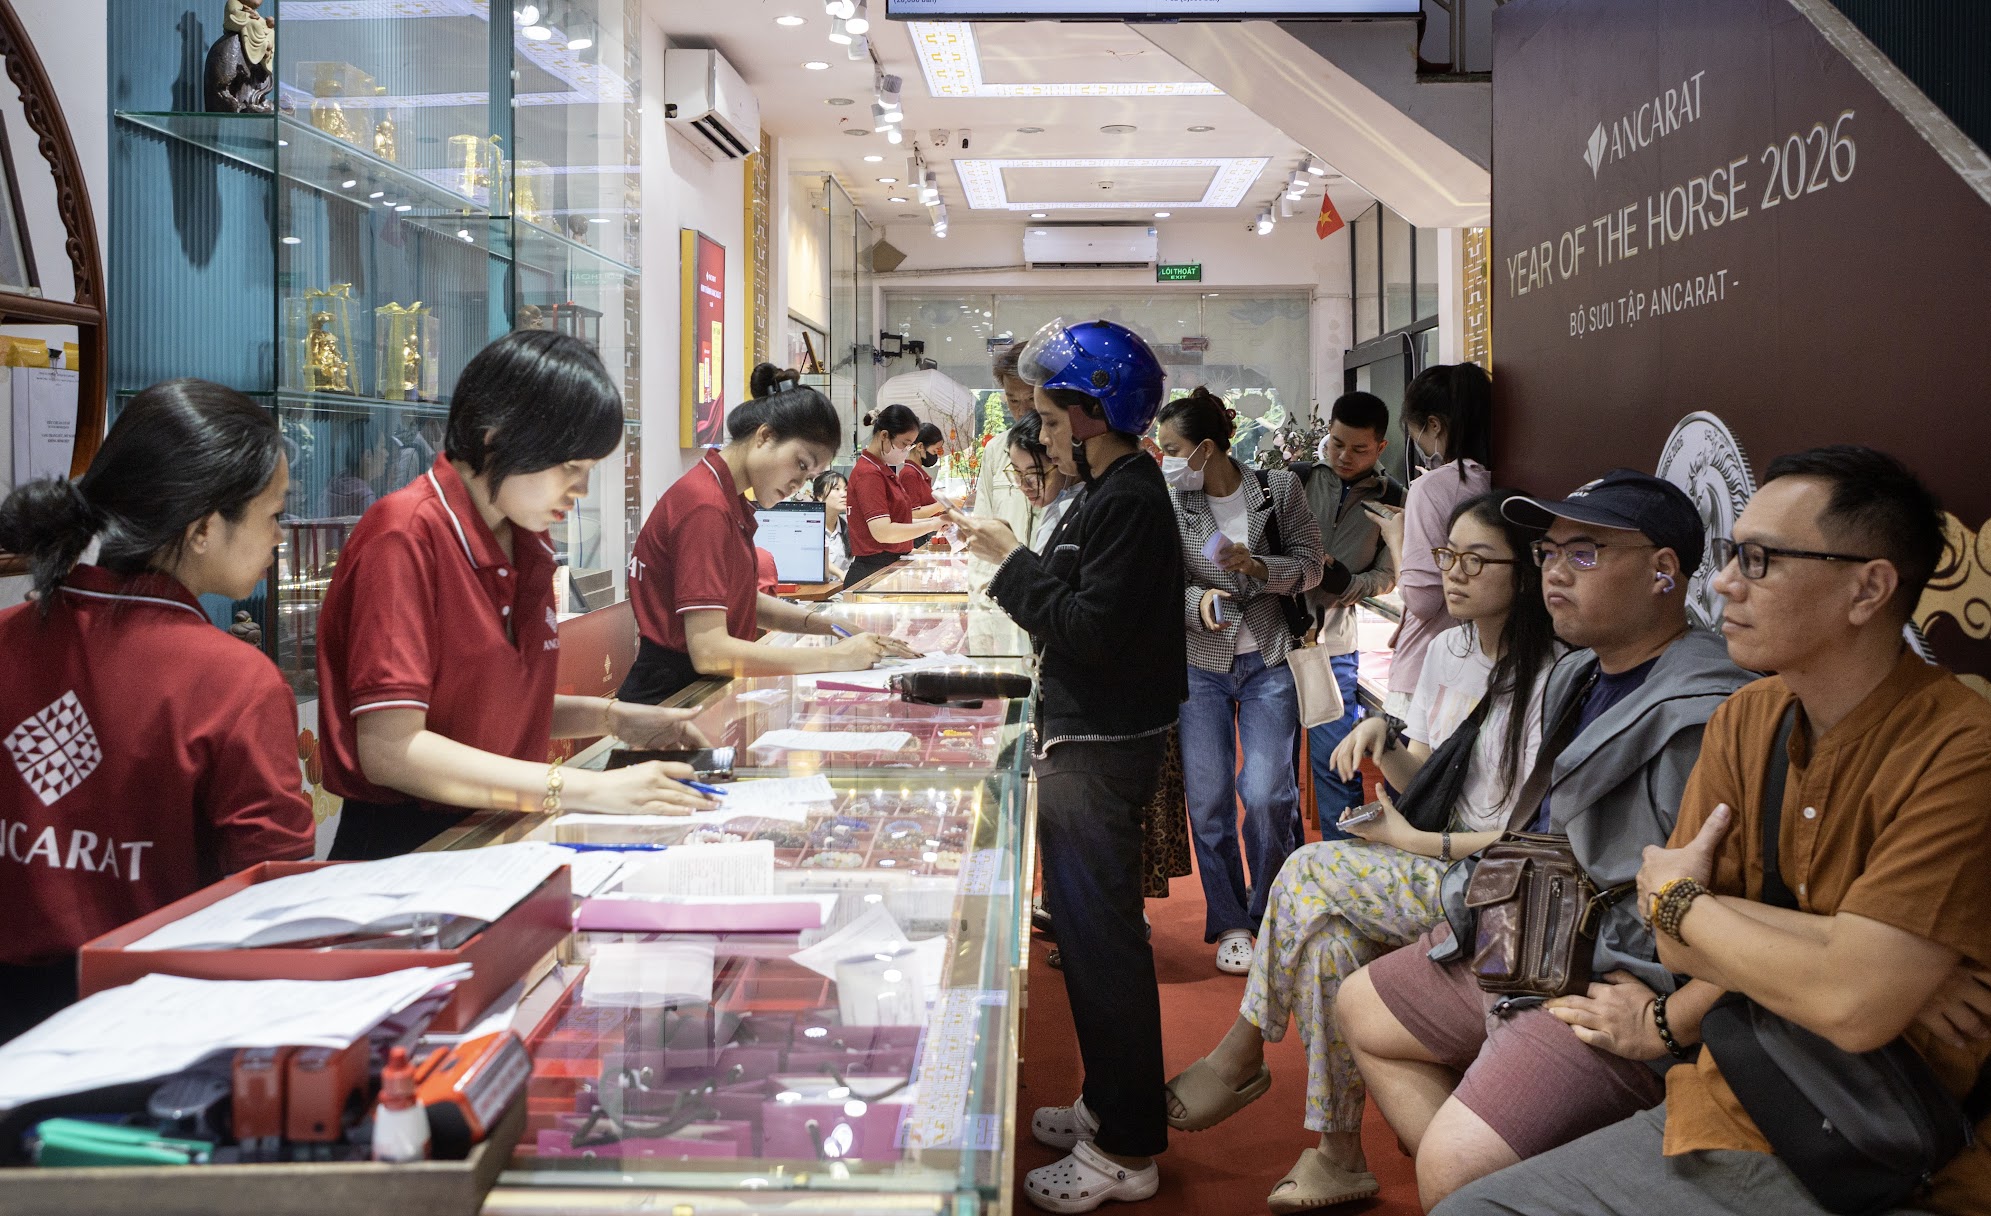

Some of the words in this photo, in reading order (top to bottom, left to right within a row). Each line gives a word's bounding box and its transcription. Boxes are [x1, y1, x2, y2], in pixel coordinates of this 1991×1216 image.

[1609, 70, 1706, 164] ANCARAT
[1506, 240, 1553, 298] YEAR
[1559, 224, 1586, 280] OF
[1593, 202, 1638, 268] THE
[1648, 154, 1748, 249] HORSE
[1760, 109, 1857, 212] 2026
[1569, 304, 1586, 339] BỘ
[1589, 301, 1614, 331] SƯU
[1618, 289, 1646, 328] TẬP
[1649, 269, 1728, 318] ANCARAT
